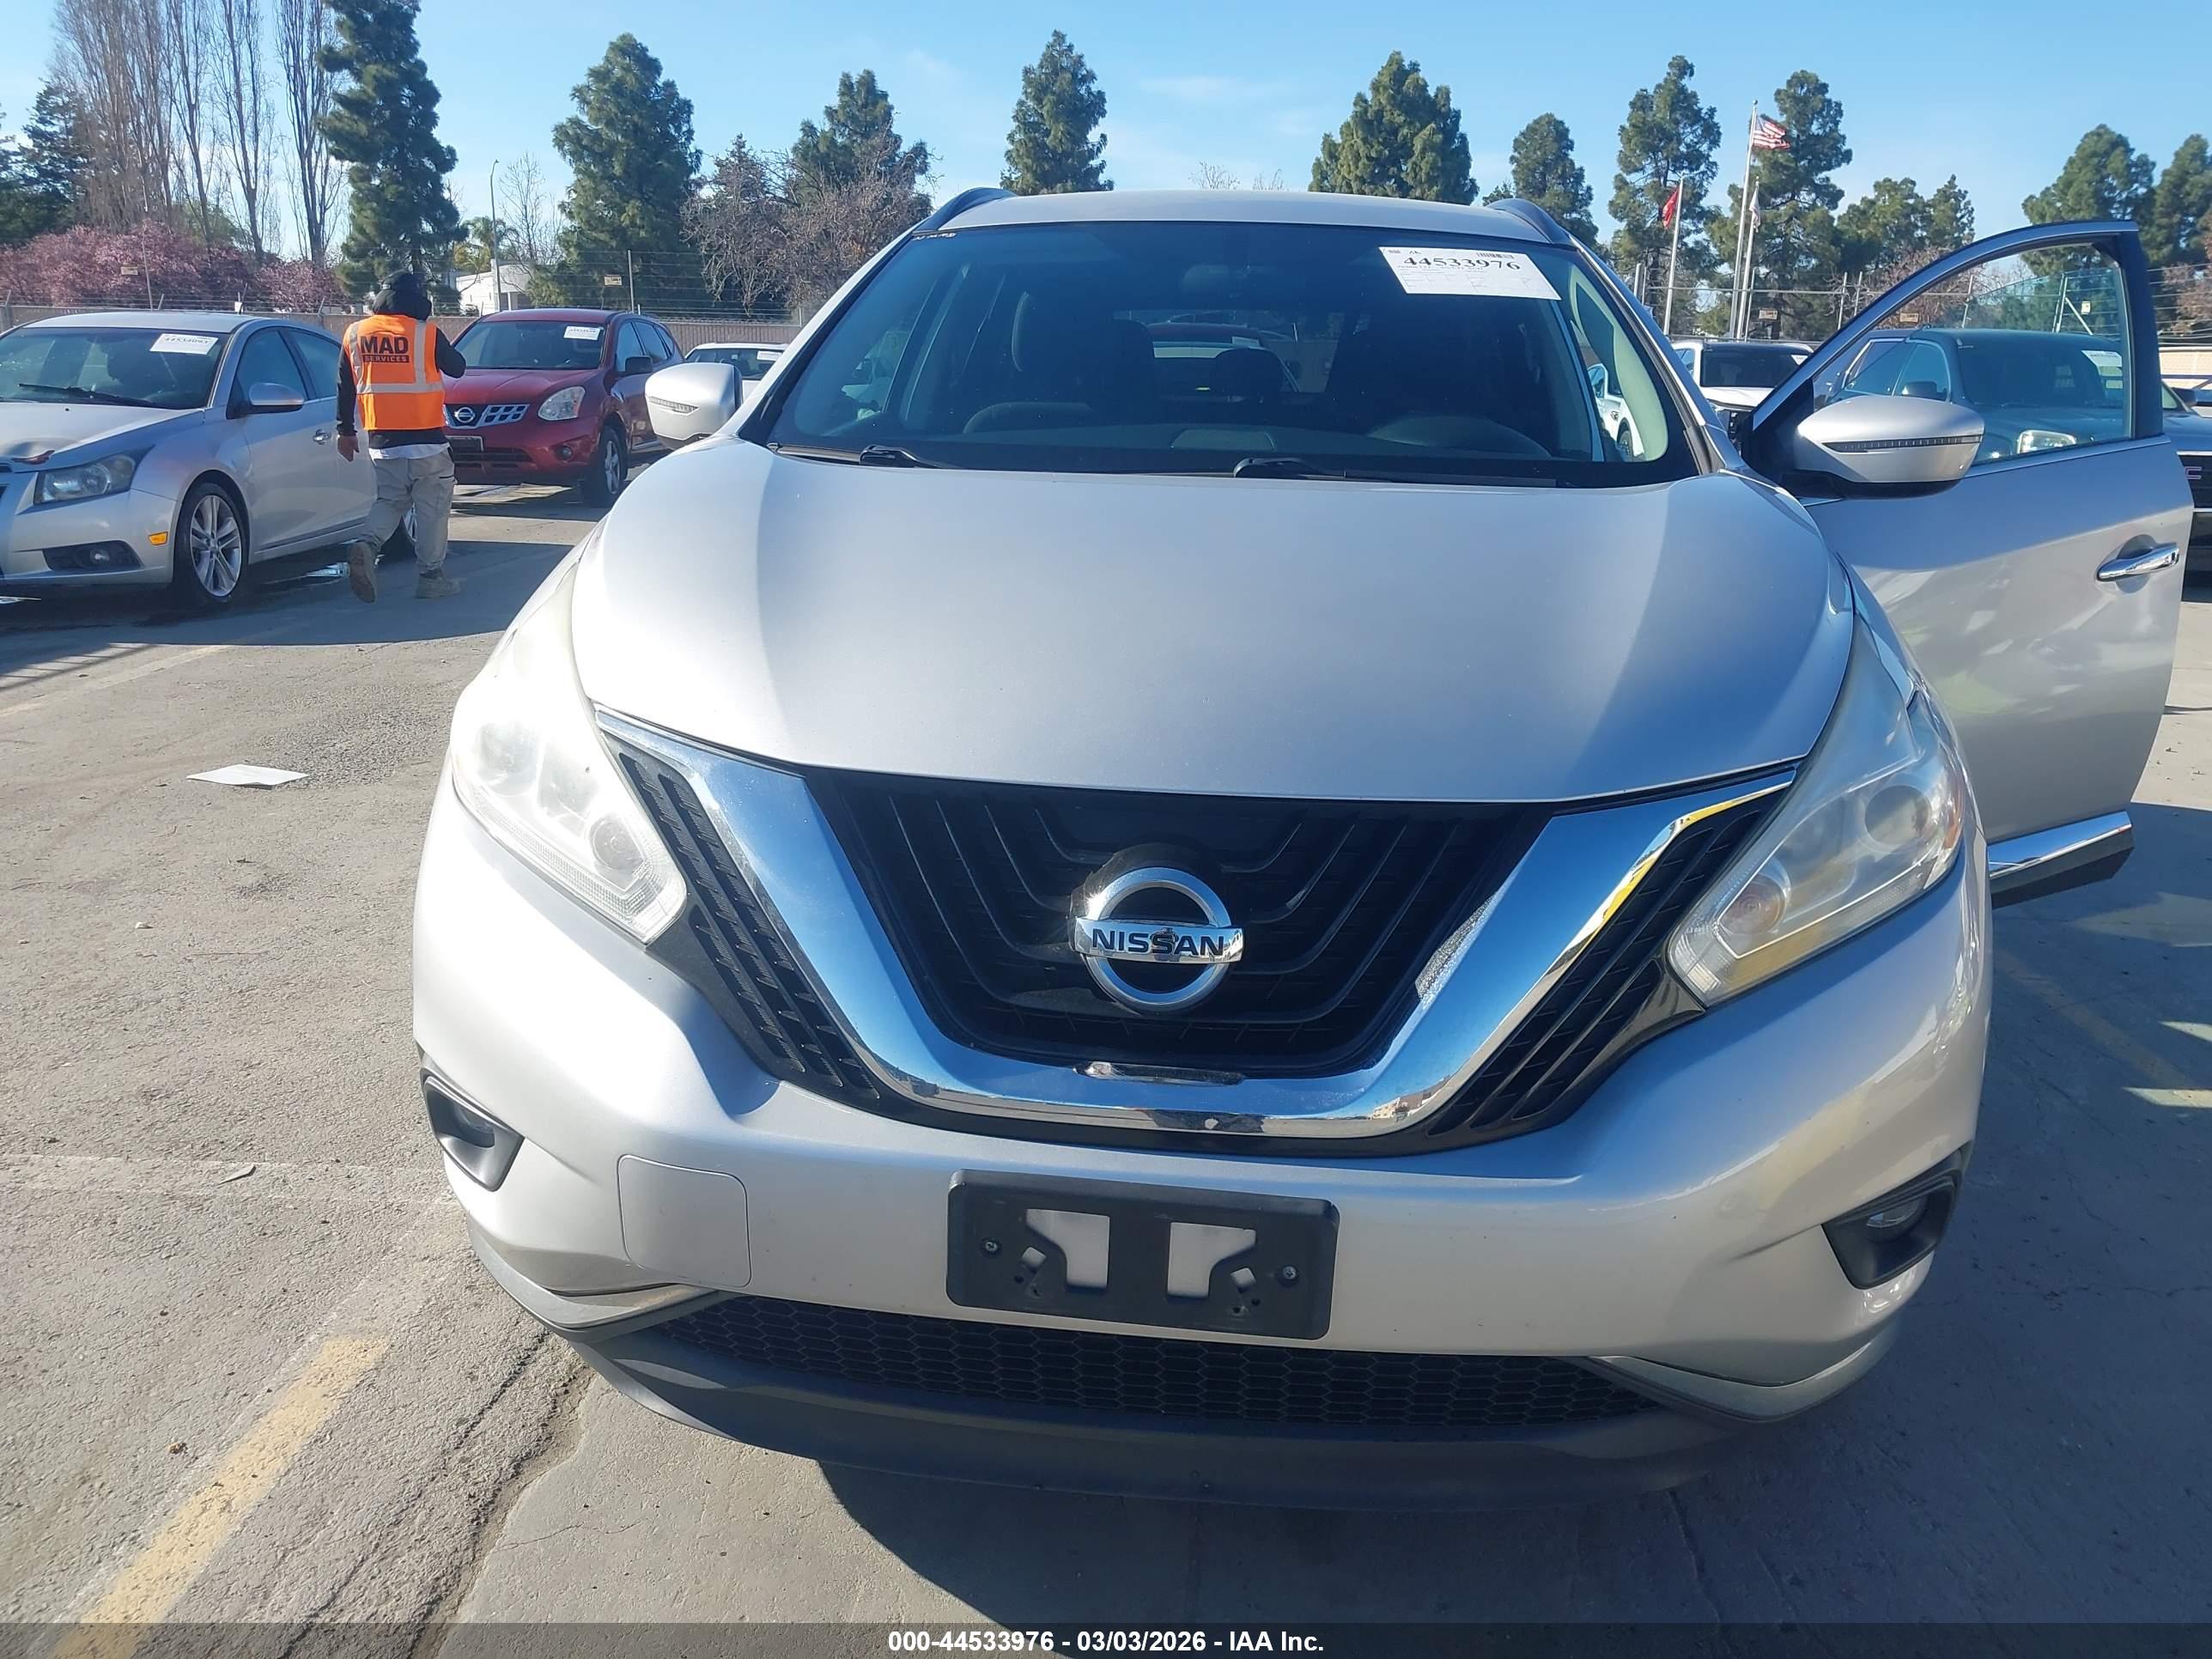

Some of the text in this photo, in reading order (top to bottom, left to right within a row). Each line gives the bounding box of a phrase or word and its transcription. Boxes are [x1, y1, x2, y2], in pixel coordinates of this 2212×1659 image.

[1403, 256, 1521, 270] 44533976
[360, 336, 410, 354] MAD
[1092, 928, 1224, 956] NISSAN
